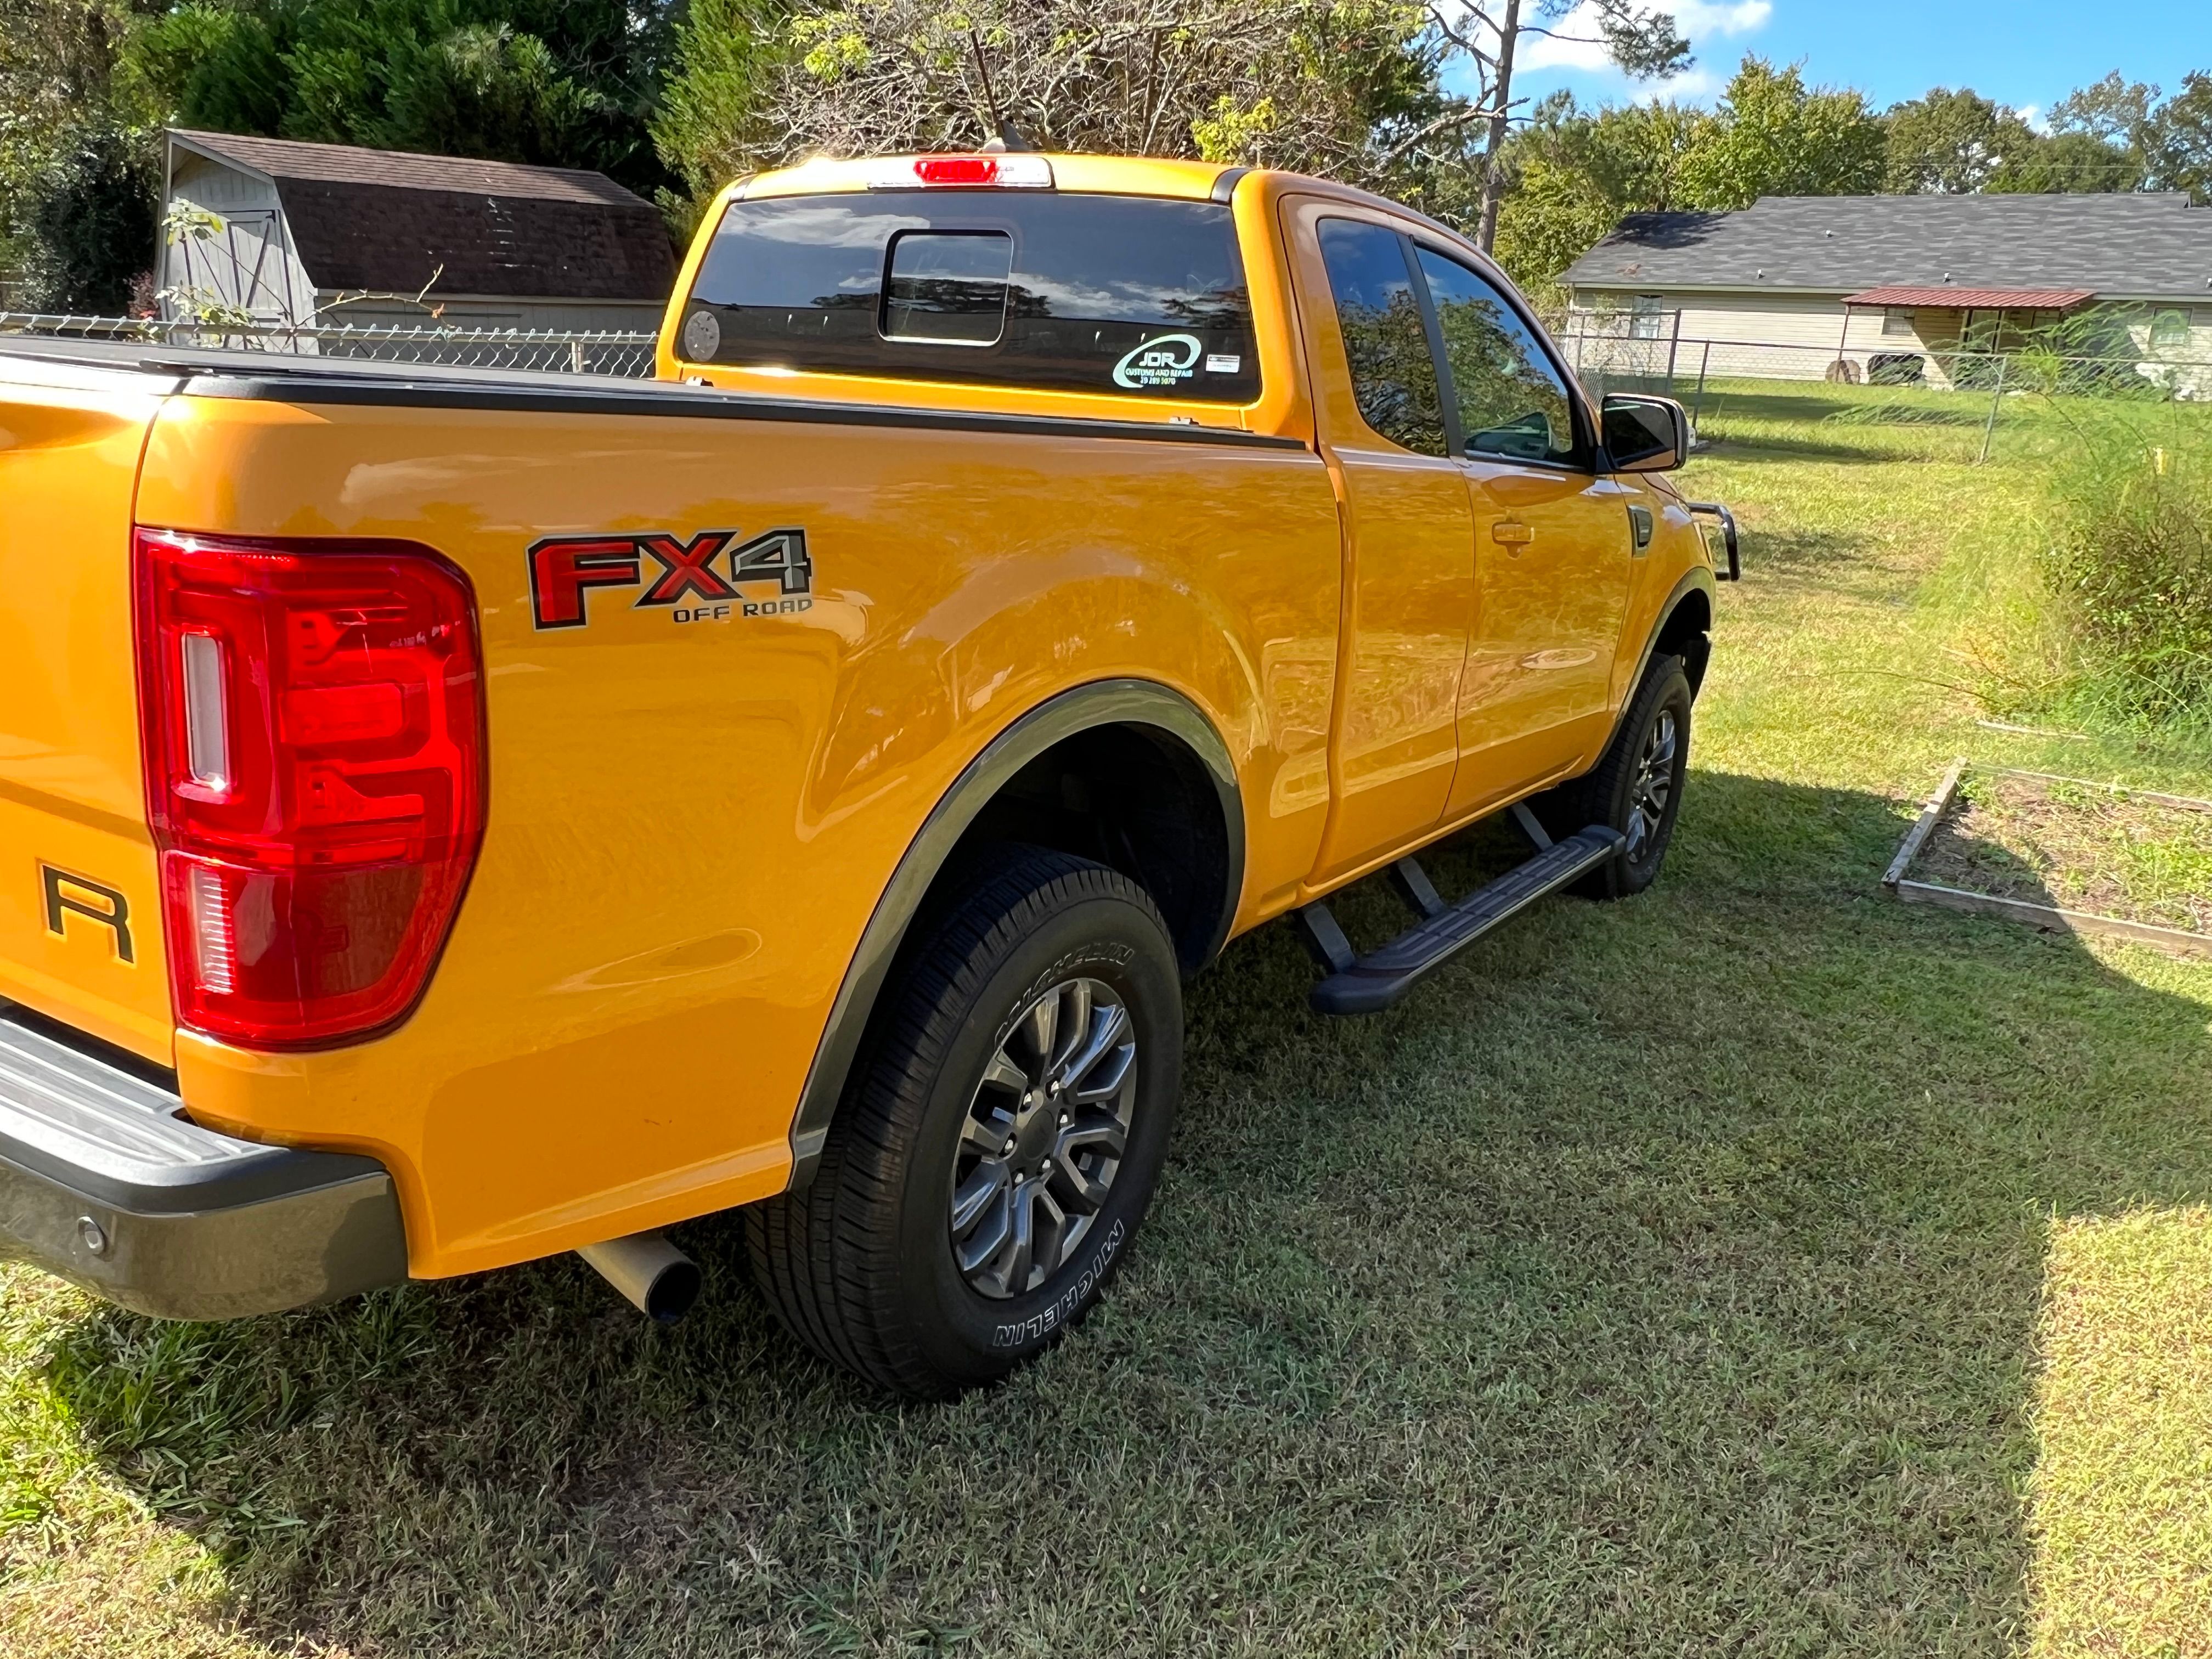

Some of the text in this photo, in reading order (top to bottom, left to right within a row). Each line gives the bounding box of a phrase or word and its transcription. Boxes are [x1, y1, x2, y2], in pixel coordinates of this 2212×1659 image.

[1125, 368, 1155, 376] CUSTOMS
[1170, 369, 1193, 377] REPAIR
[1138, 352, 1175, 367] JDR
[527, 528, 812, 631] FX4
[673, 599, 813, 624] OFF ROAD
[40, 863, 134, 964] R
[992, 1217, 1125, 1347] MICHELIN
